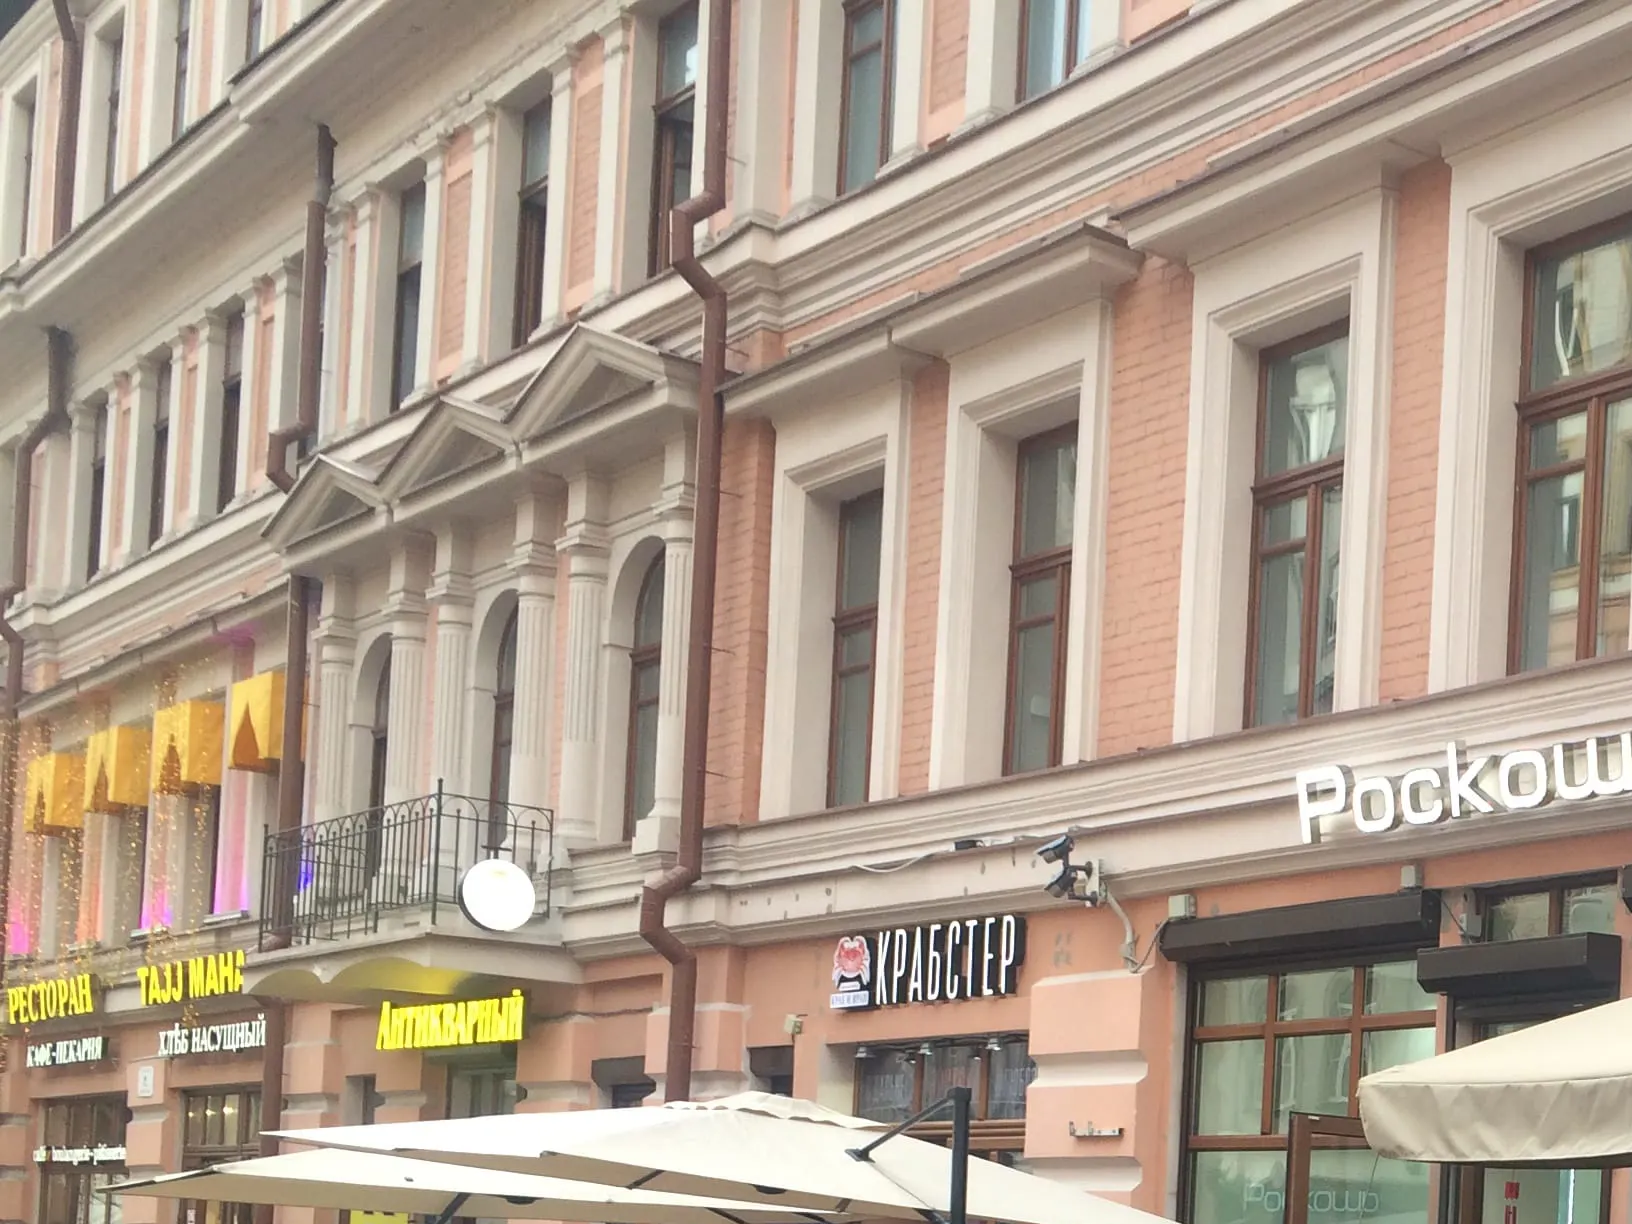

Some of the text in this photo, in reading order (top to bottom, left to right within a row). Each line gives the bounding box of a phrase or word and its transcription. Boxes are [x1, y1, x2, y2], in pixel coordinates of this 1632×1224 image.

[875, 914, 1016, 1005] КРАБСТЕР
[8, 974, 93, 1024] РЕСТОРАН
[191, 1014, 266, 1053] НАСУЩНЫЙ
